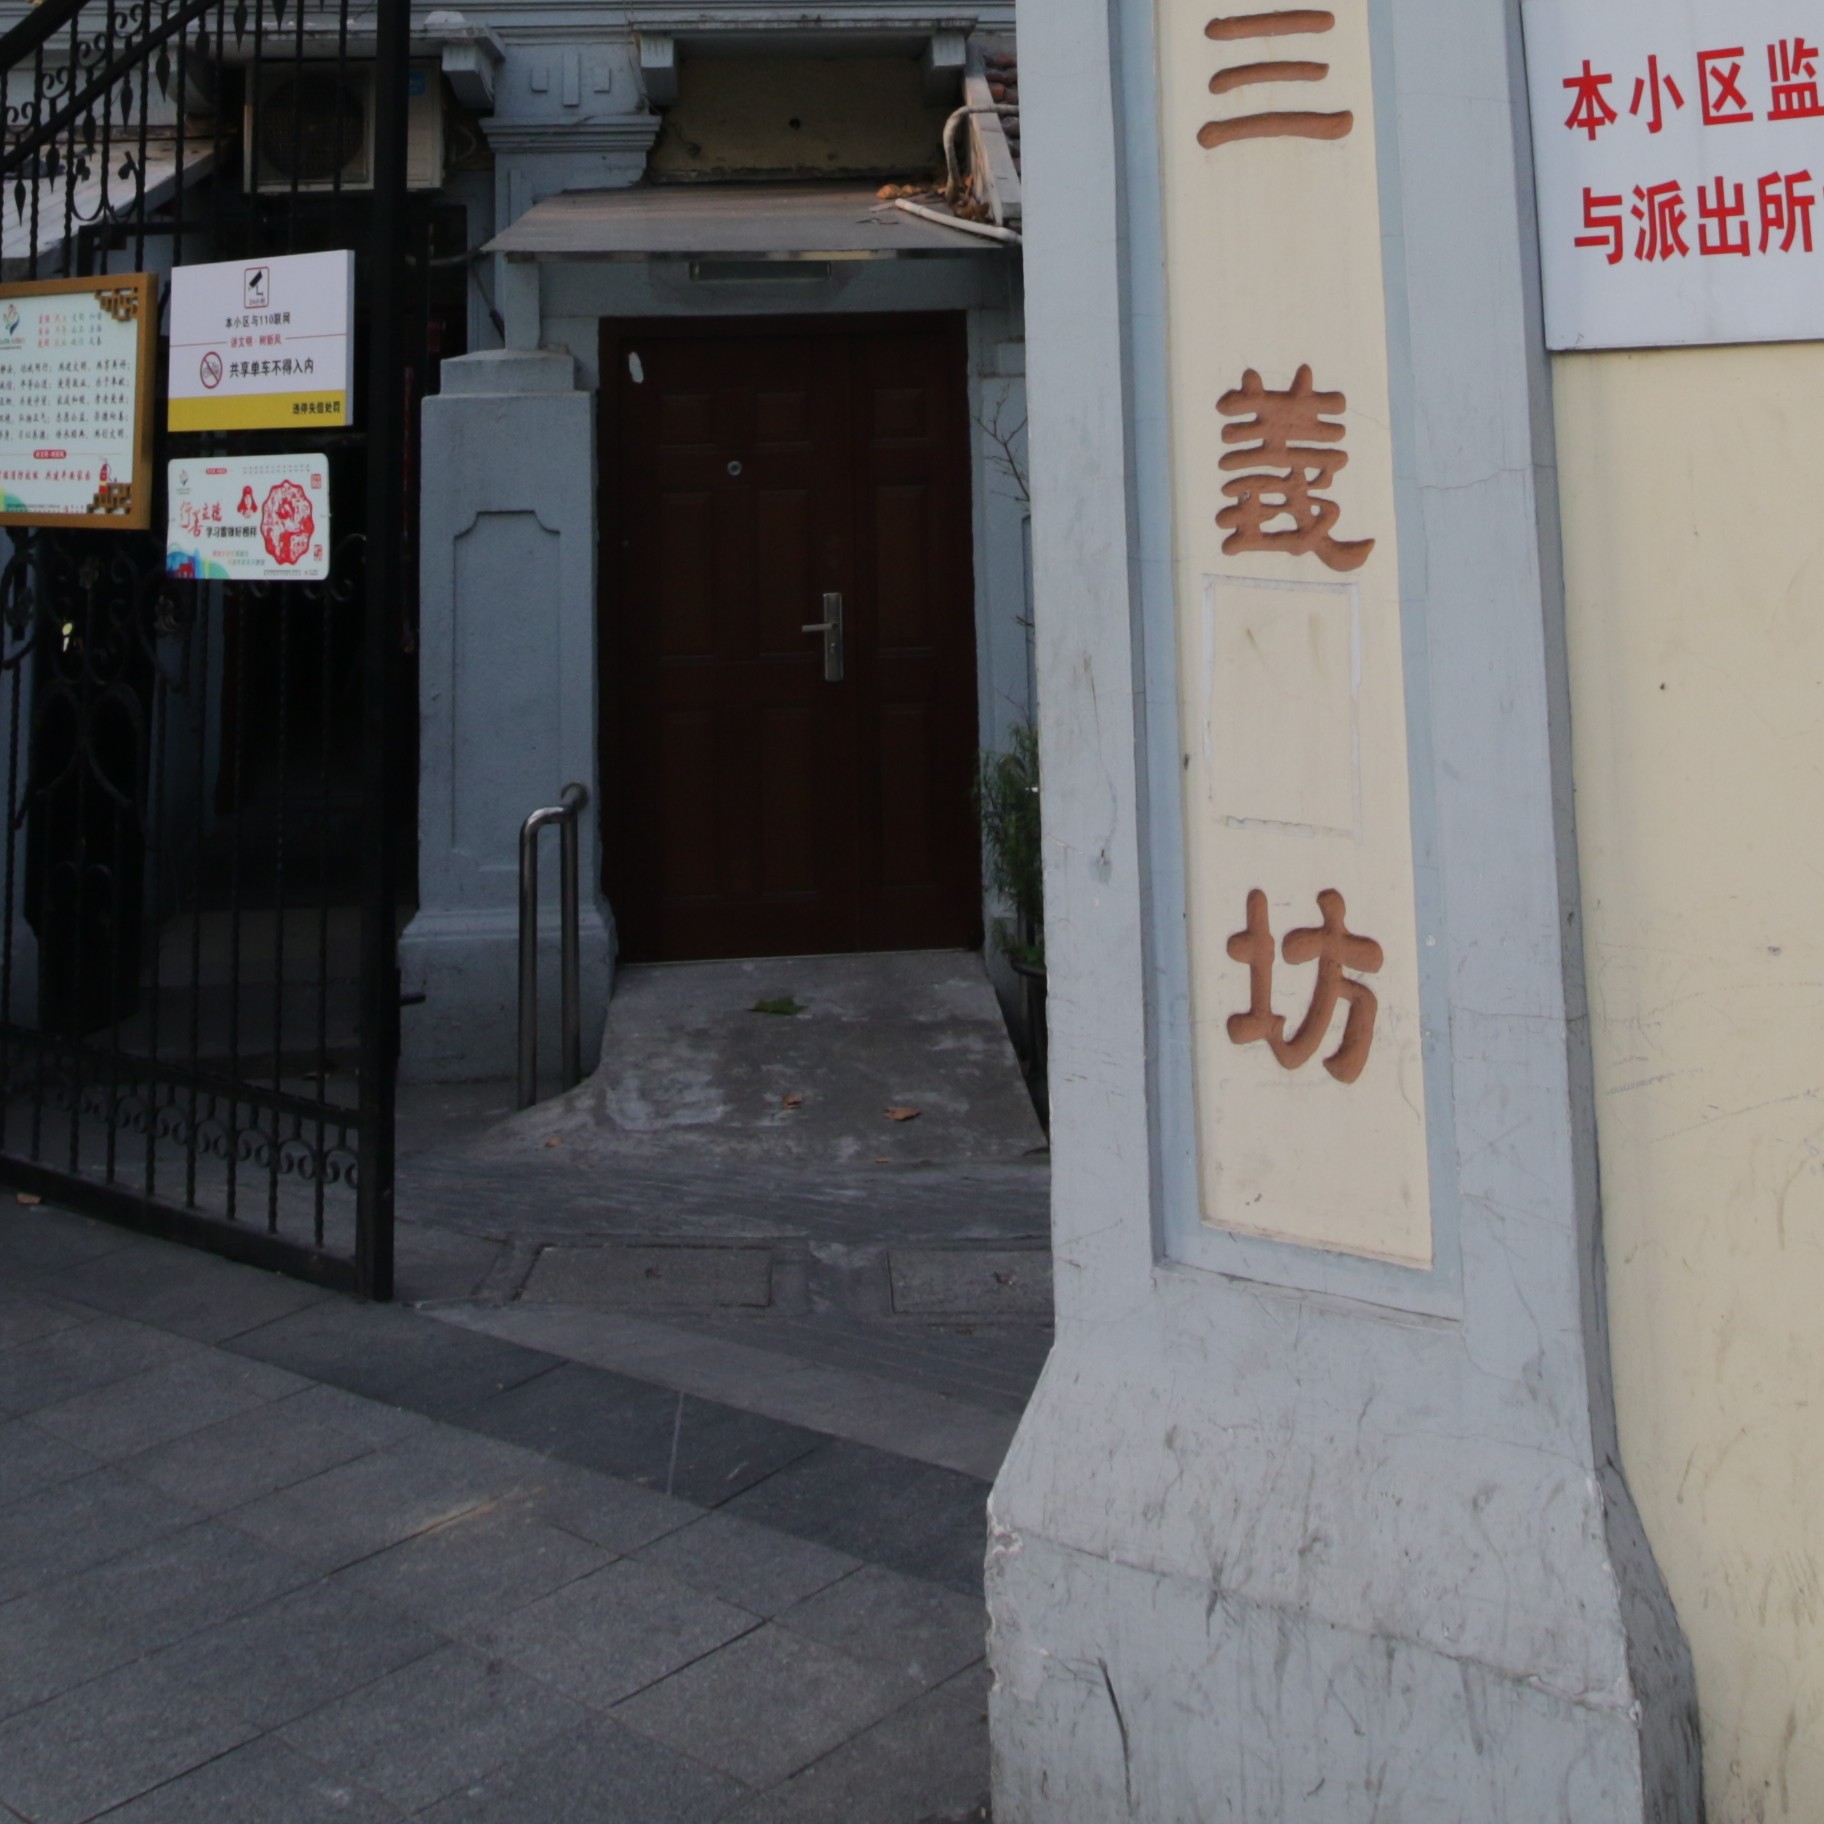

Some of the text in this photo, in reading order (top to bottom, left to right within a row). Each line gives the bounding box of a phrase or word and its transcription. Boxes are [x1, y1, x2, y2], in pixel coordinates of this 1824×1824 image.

[226, 312, 290, 328] 本小区与110联网
[230, 357, 313, 378] 共享单车不得入内
